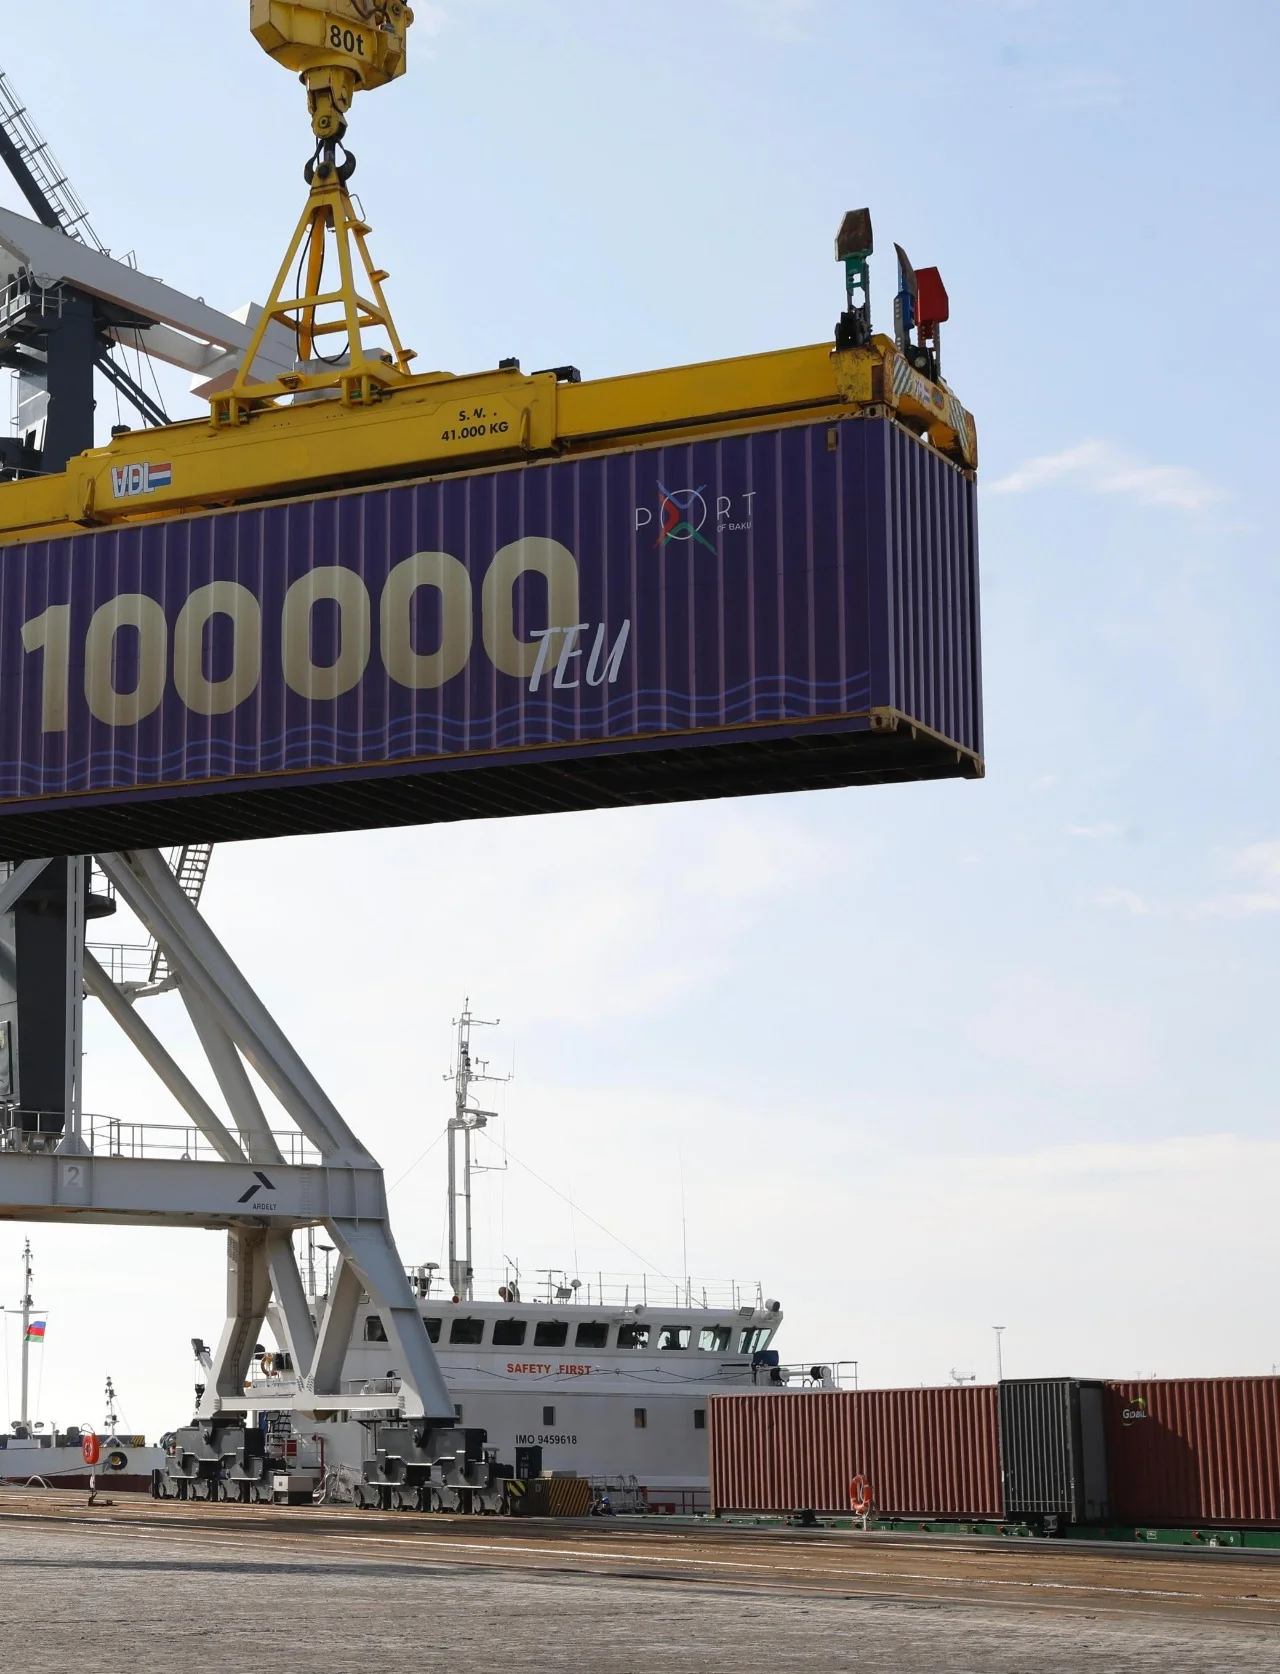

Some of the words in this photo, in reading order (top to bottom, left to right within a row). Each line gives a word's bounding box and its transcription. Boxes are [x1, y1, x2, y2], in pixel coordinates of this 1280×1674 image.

[330, 25, 364, 56] 80t
[441, 425, 486, 441] 41.000
[489, 421, 509, 434] KG
[111, 462, 155, 498] VDL
[717, 523, 727, 532] OF
[729, 521, 752, 531] BAKU
[528, 619, 631, 692] TEU
[67, 1166, 80, 1186] 2
[252, 1203, 277, 1211] ARDELT
[507, 1363, 551, 1374] SAFETY
[558, 1364, 592, 1375] FIRST
[515, 1434, 535, 1445] IMO
[537, 1434, 578, 1445] 9459618
